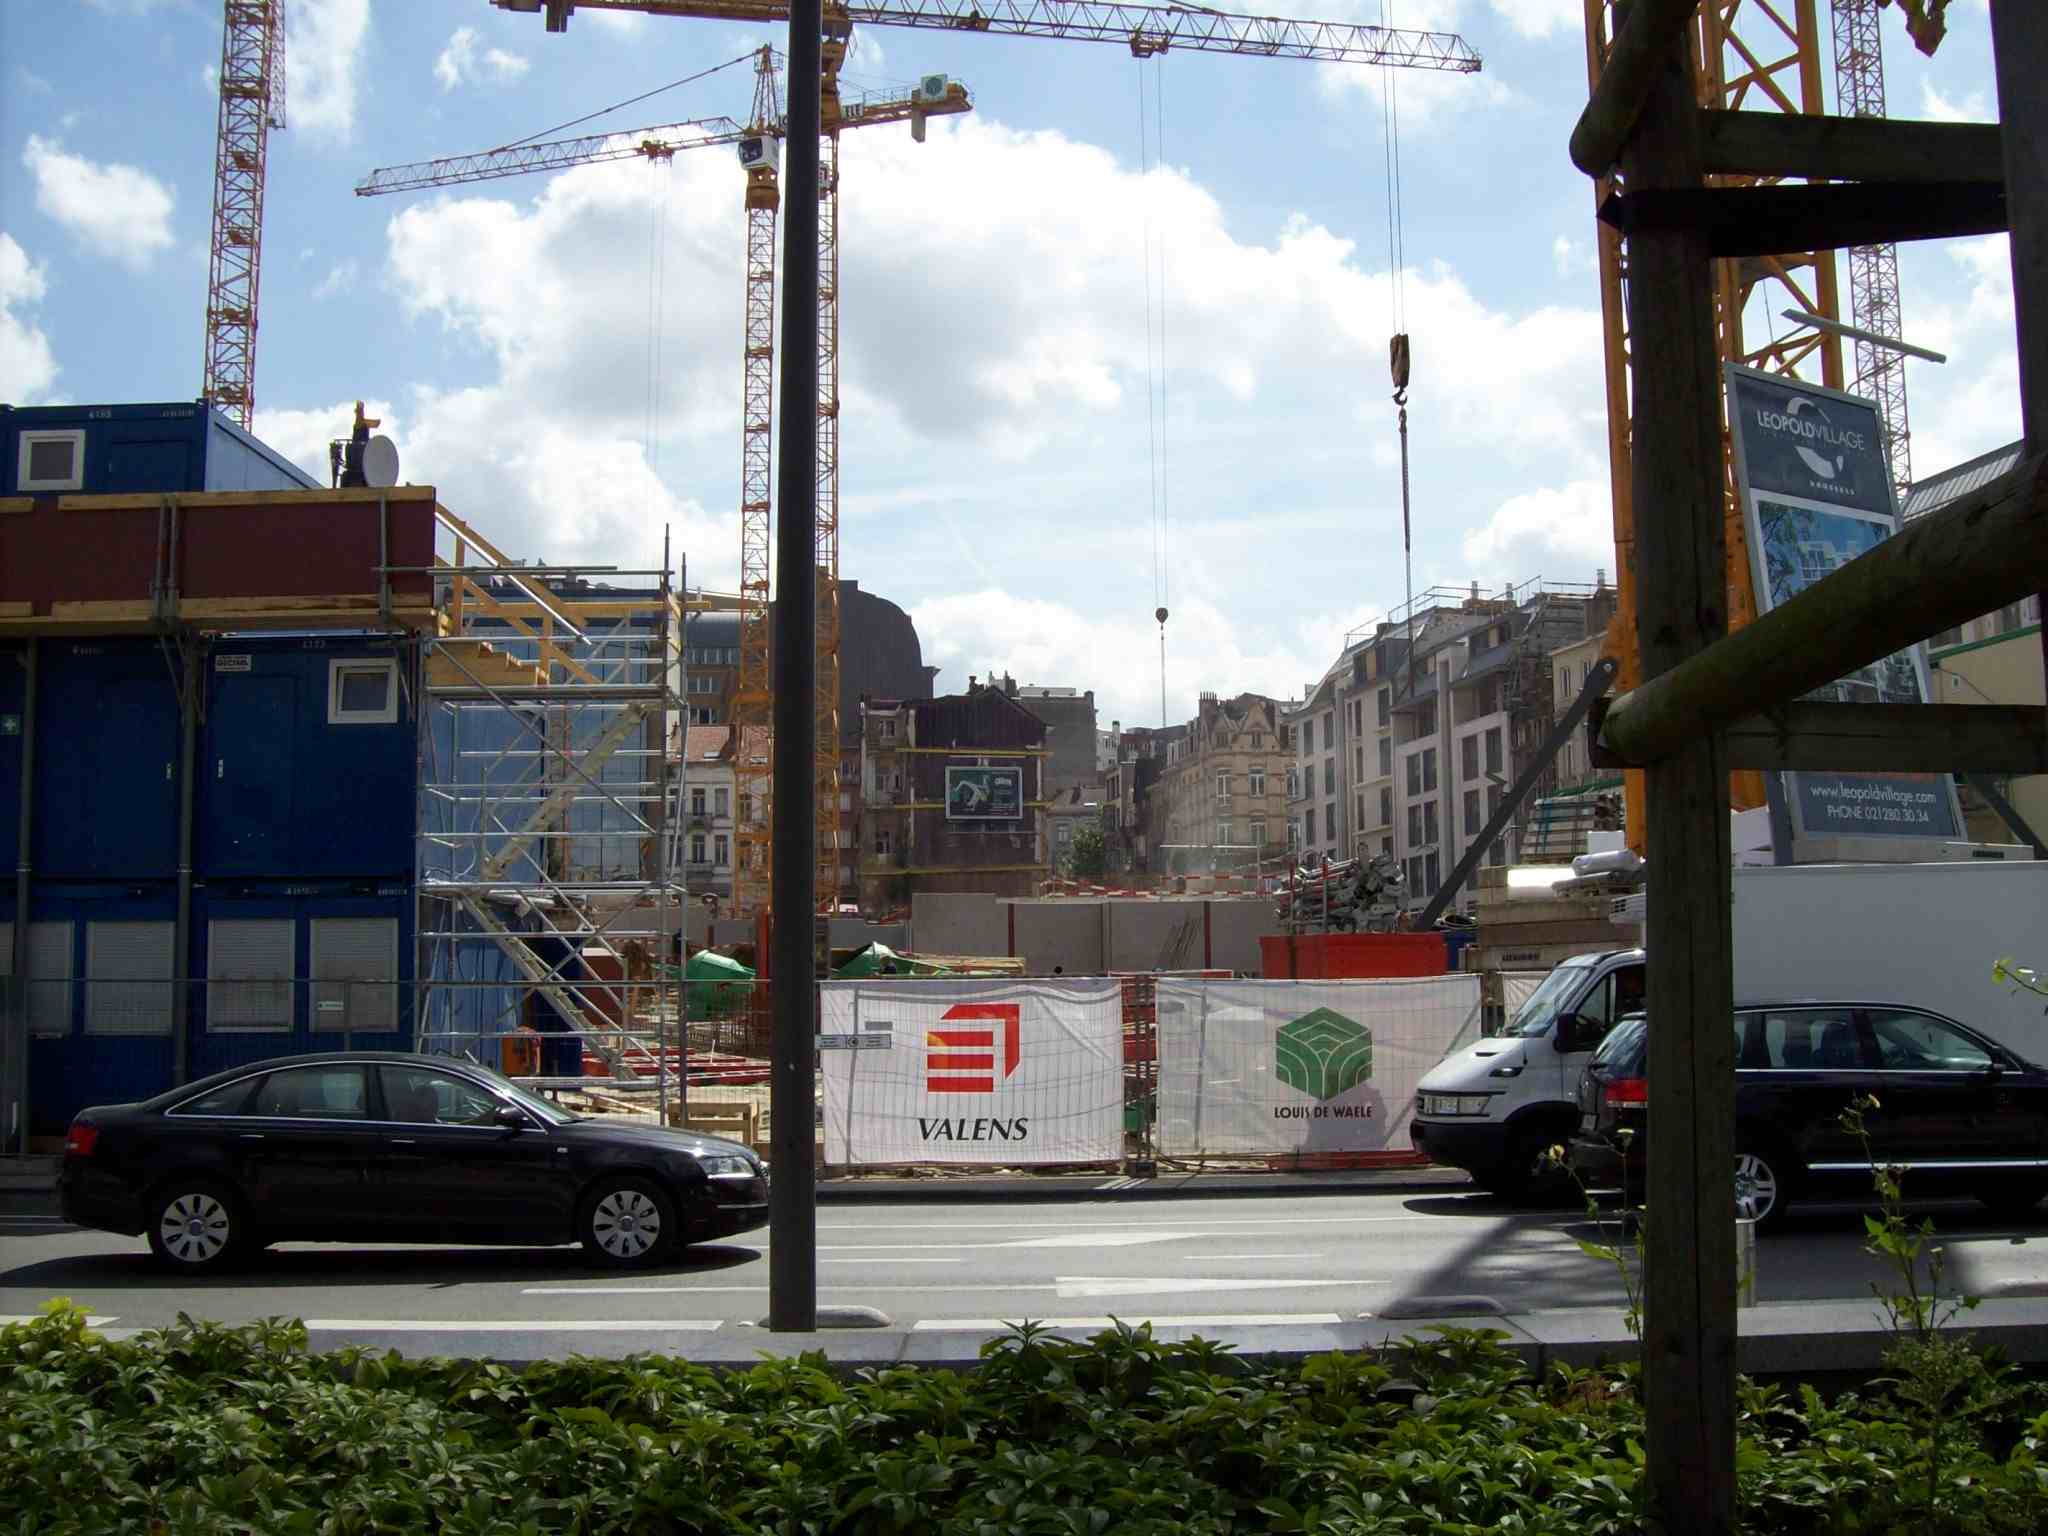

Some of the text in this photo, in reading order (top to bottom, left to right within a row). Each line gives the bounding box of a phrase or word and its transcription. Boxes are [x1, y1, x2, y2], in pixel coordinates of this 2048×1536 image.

[1809, 781, 1937, 806] www.leopoldvillage.com
[1274, 1105, 1373, 1119] LOUIS DE WAELE
[918, 1117, 1028, 1141] VALENS
